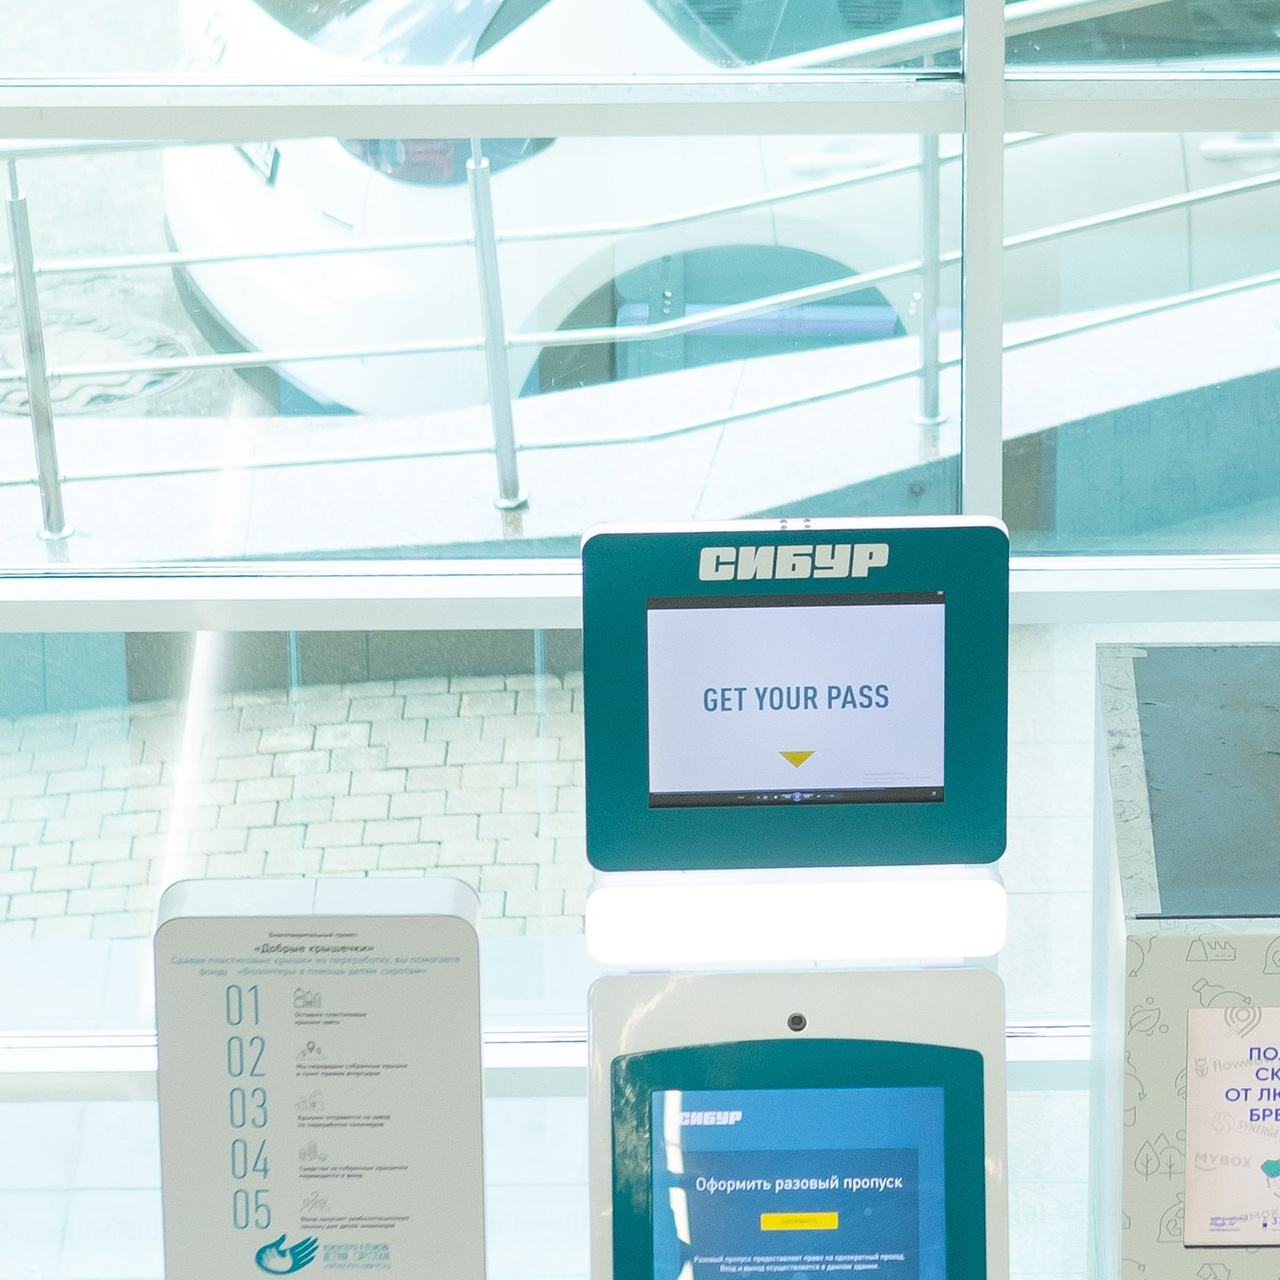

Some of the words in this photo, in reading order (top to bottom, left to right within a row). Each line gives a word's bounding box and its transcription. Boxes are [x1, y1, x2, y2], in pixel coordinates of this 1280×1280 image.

[698, 543, 890, 582] СИБУР
[703, 687, 747, 713] GET
[754, 686, 819, 711] YOUR
[827, 684, 890, 710] PASS
[225, 984, 260, 1026] 01
[227, 1036, 266, 1078] 02
[230, 1087, 269, 1129] 03
[1225, 1088, 1251, 1102] ОТ
[680, 1111, 743, 1126] СИБУР
[231, 1138, 270, 1180] 04
[695, 1176, 772, 1195] Оформить
[775, 1174, 840, 1195] разовый
[843, 1175, 904, 1195] пропуск
[232, 1189, 271, 1230] 05
